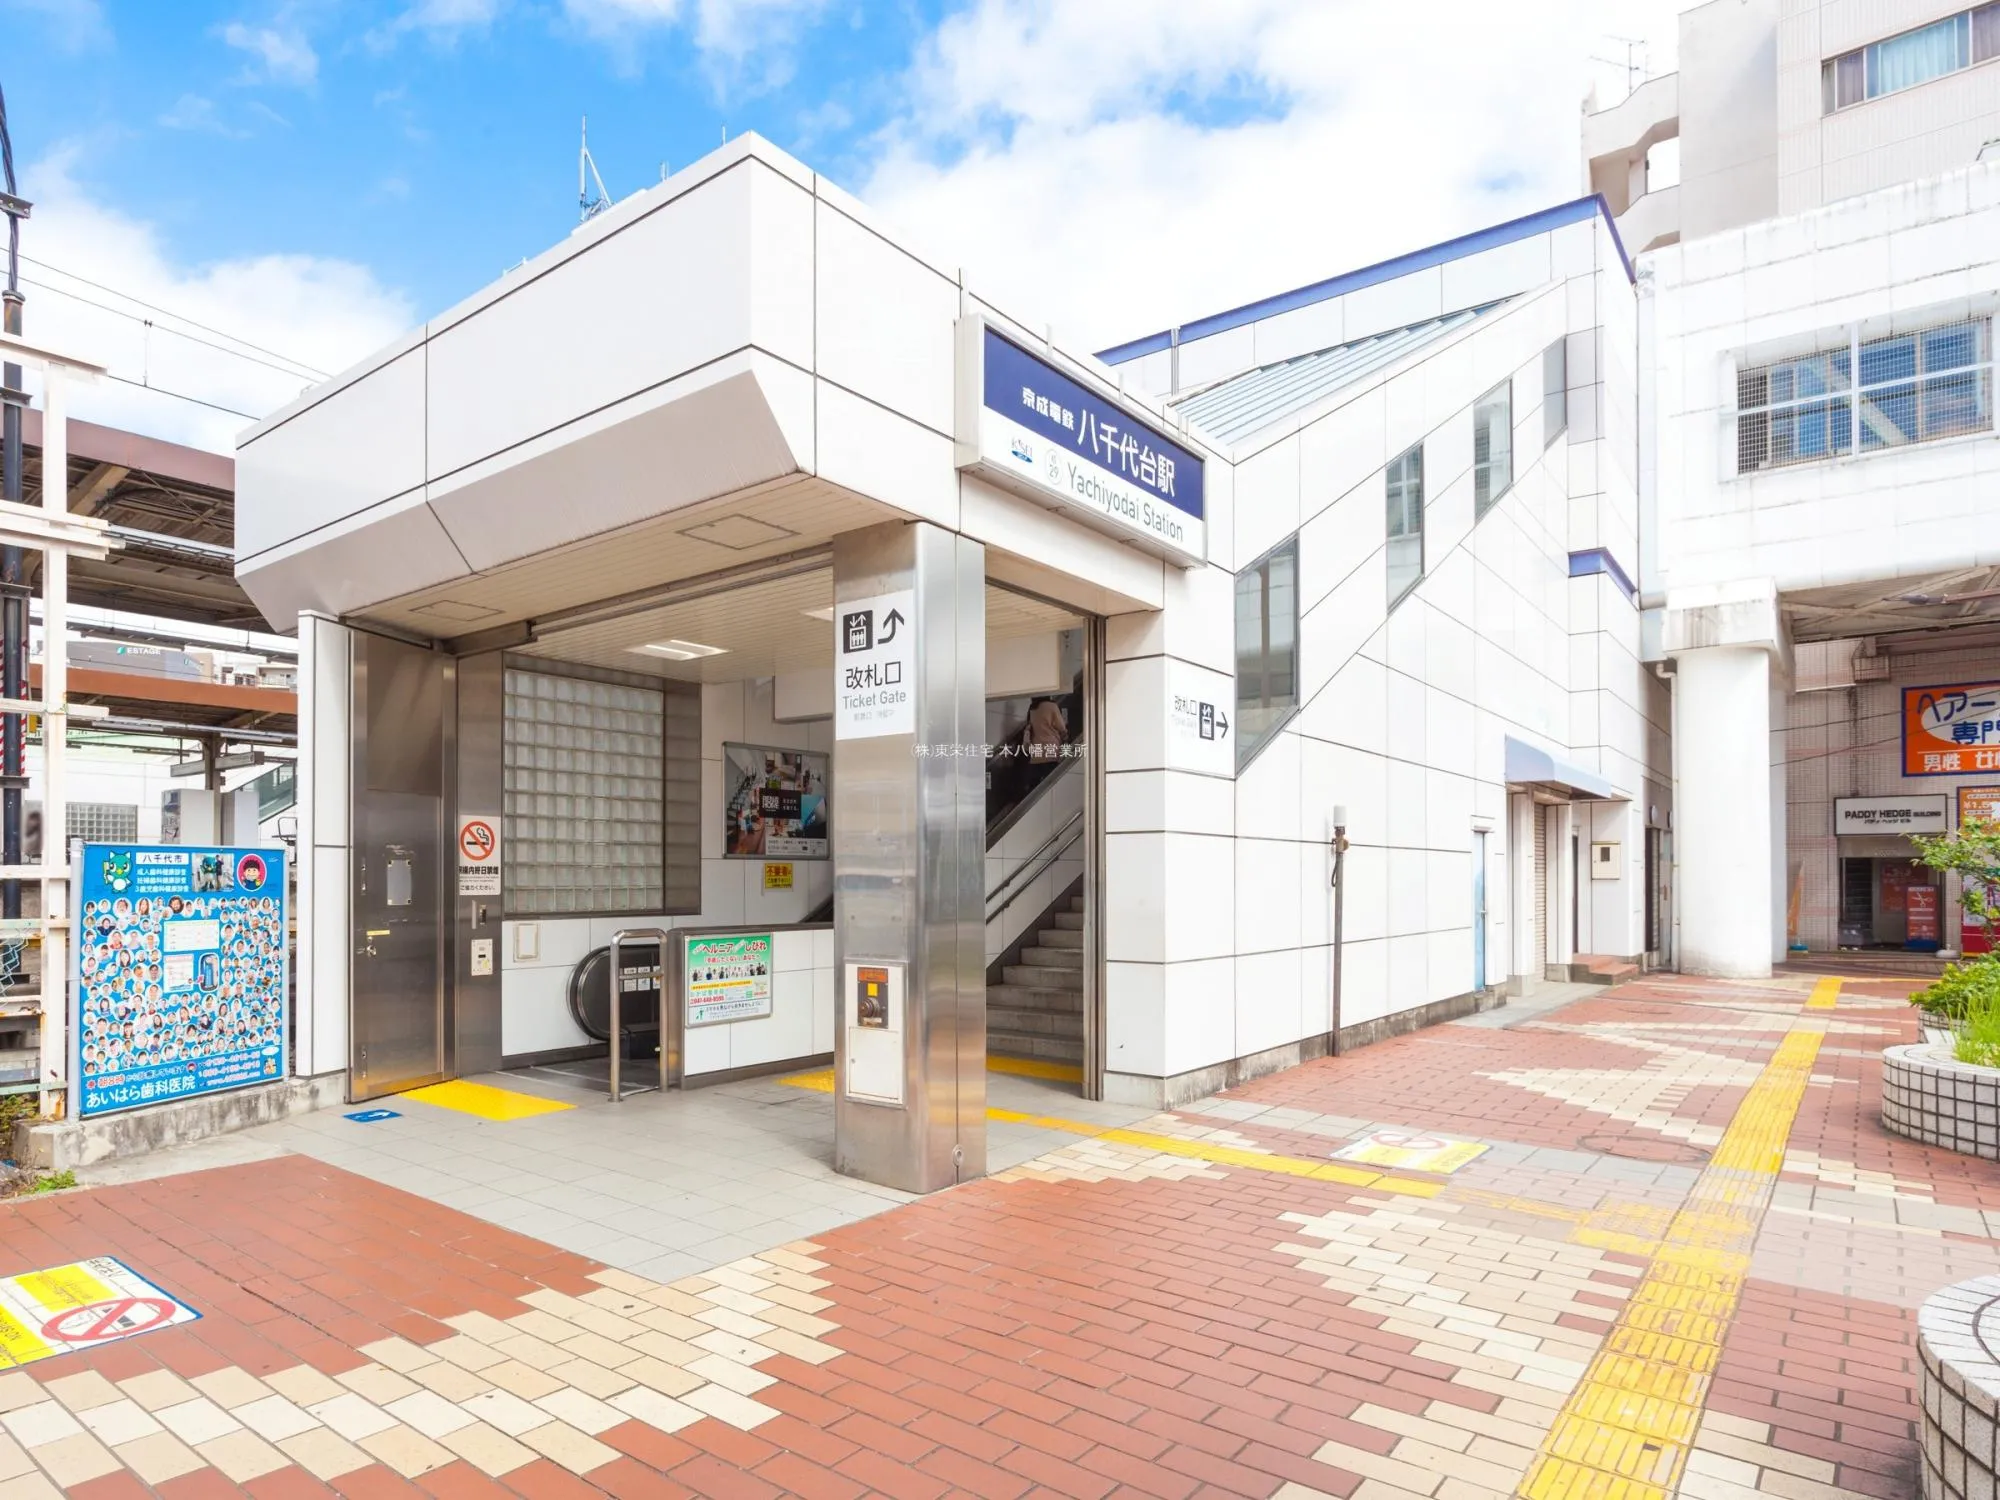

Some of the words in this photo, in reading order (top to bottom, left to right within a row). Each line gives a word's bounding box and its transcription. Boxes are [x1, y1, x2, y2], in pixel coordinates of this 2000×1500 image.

[1022, 386, 1075, 431] 京成電鉄
[1077, 408, 1176, 498] 八千代台駅
[1066, 462, 1141, 522] Yachiyodai
[1143, 501, 1184, 543] Station
[846, 661, 901, 690] 改札口
[843, 693, 876, 710] Ticket
[879, 690, 907, 705] Gate
[1174, 695, 1198, 716] 改札口
[1917, 691, 1996, 723] ヘアー
[1923, 752, 1961, 772] 男性
[1845, 810, 1877, 819] PADDY
[1879, 809, 1911, 818] HEDGE
[142, 854, 183, 863] 八千代市
[702, 943, 734, 954] ヘルニア
[745, 941, 767, 952] しびれ
[86, 1076, 196, 1109] あいはら歯科医院
